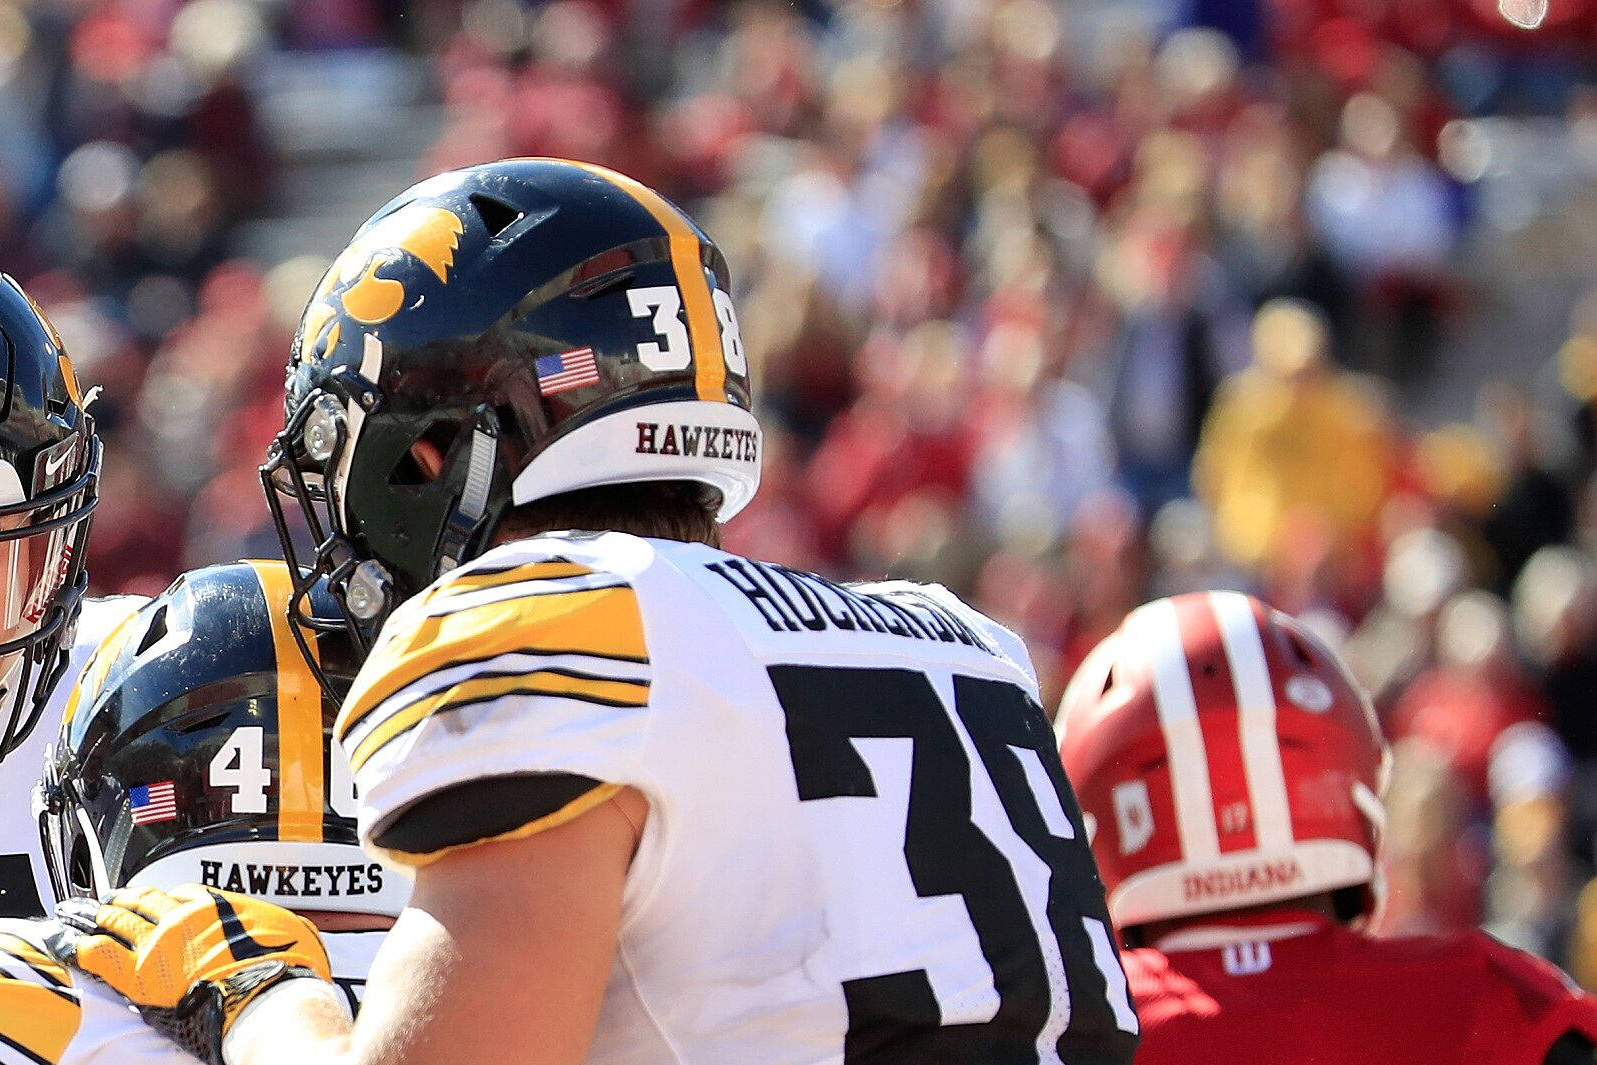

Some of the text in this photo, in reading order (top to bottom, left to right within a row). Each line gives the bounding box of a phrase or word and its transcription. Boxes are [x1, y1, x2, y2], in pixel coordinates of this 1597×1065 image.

[626, 286, 747, 378] 38
[635, 422, 757, 462] HAWKEYES
[201, 861, 383, 897] HAWKEYES
[1183, 857, 1301, 901] INDIANA
